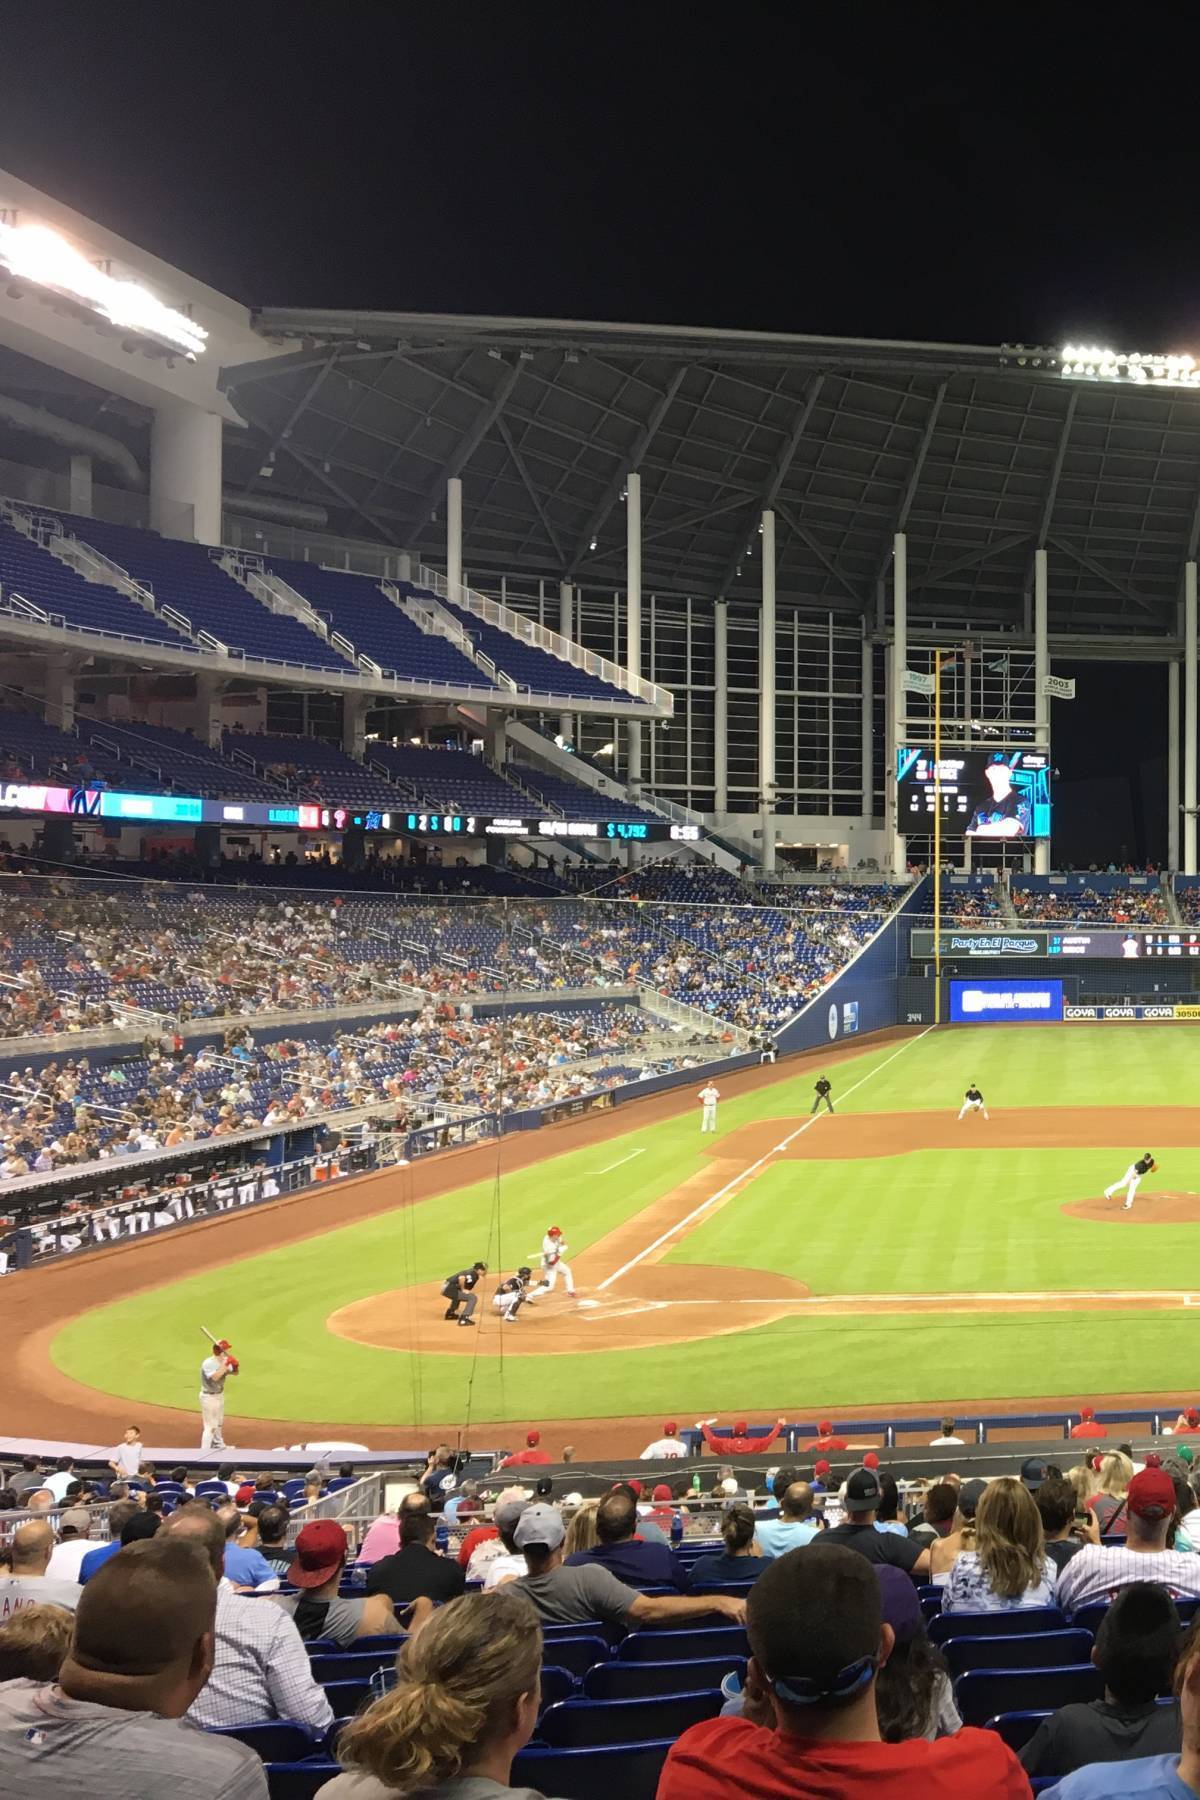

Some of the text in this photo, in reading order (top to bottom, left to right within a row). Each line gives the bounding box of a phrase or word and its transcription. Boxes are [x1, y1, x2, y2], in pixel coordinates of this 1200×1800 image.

[1047, 677, 1070, 689] 2003
[951, 937, 979, 952] Party
[1001, 937, 1038, 953] Parque
[1066, 1008, 1096, 1018] GOYA
[1105, 1008, 1135, 1018] GOYA
[1144, 1007, 1173, 1017] GOYA
[907, 1013, 922, 1023] 344
